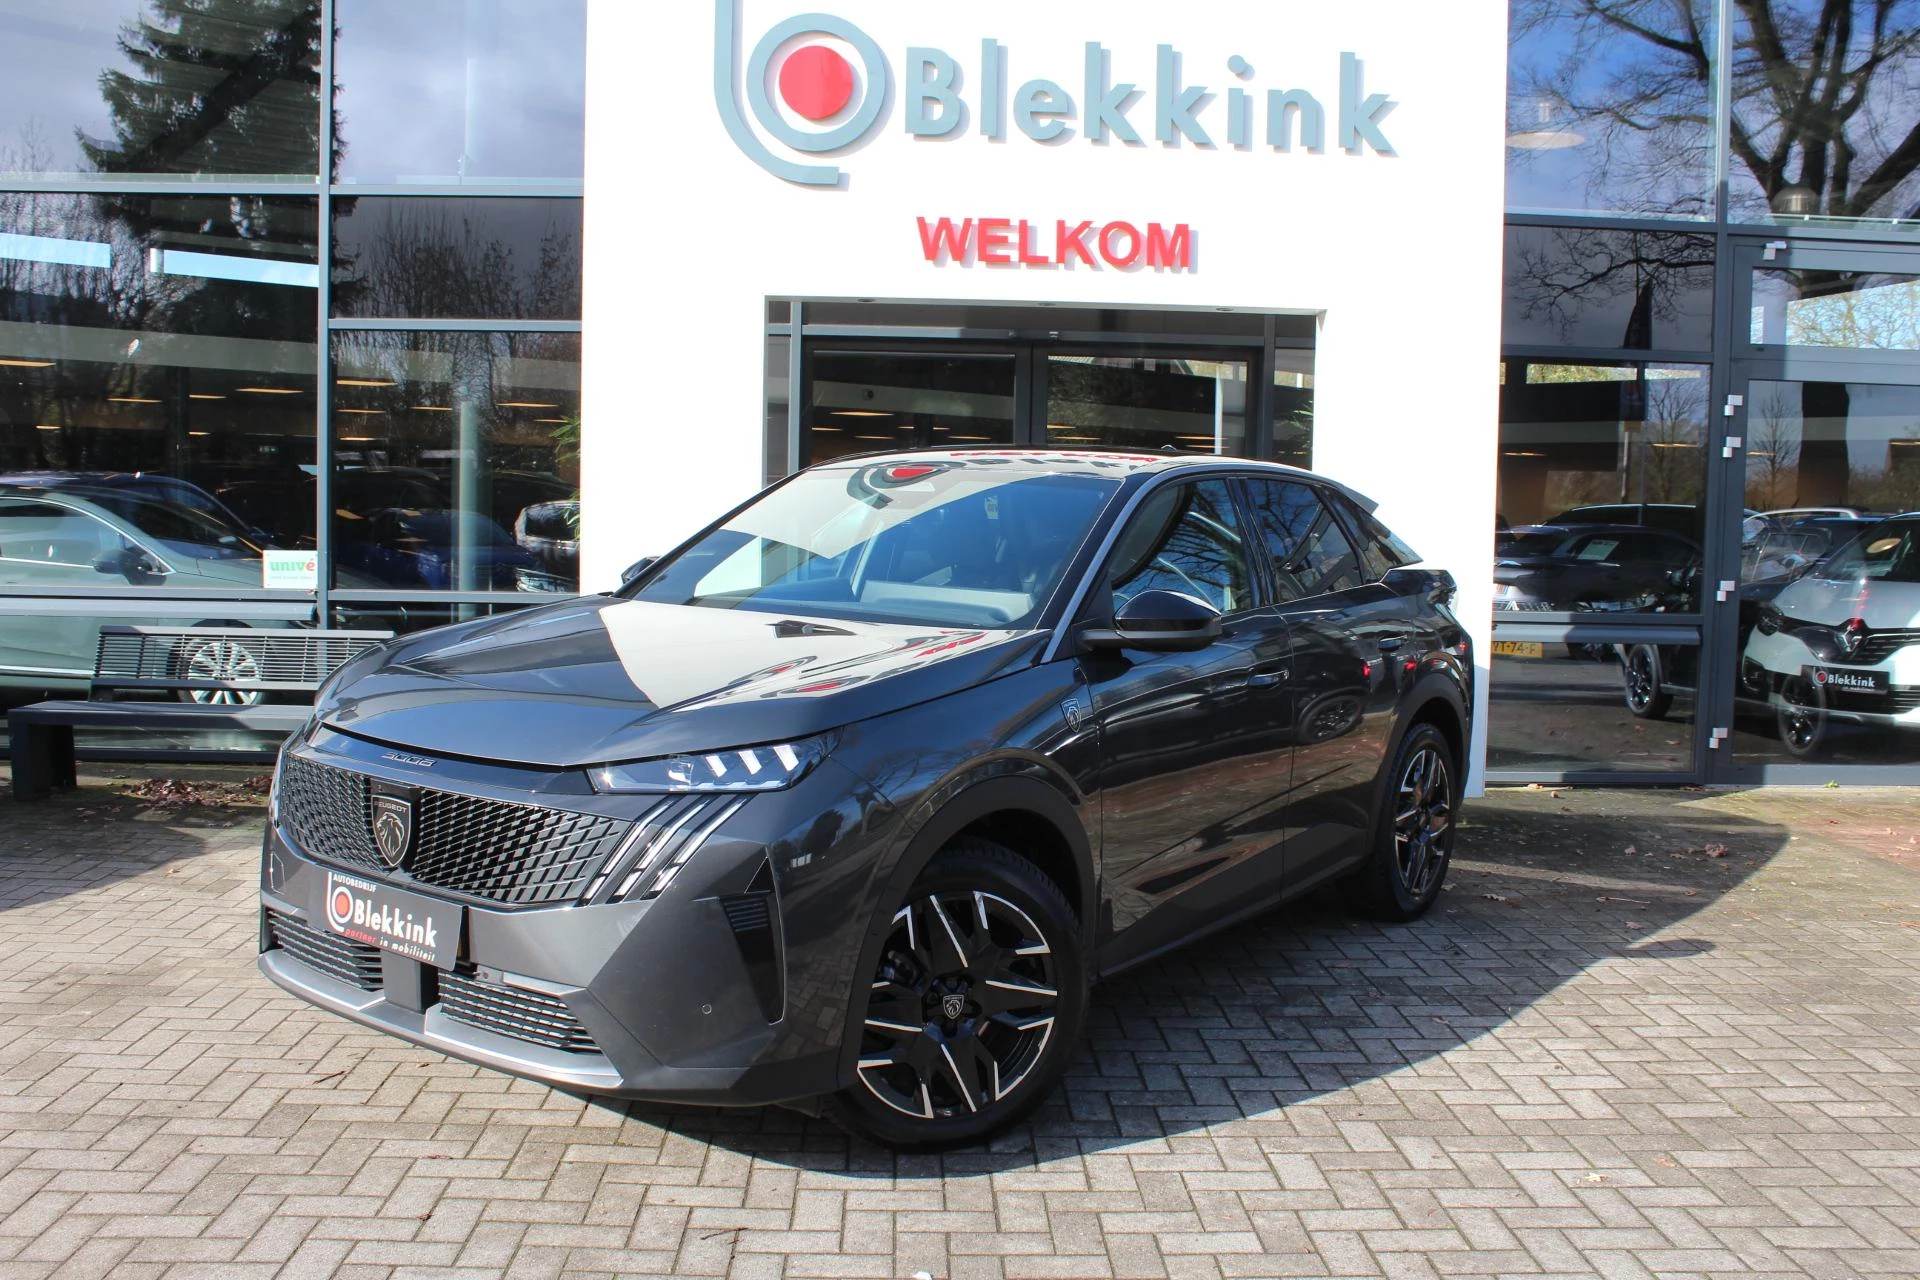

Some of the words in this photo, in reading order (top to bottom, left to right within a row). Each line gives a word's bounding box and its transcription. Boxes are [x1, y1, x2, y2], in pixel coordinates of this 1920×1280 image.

[904, 38, 1393, 153] Blekkink
[916, 216, 1191, 269] WELKOM
[270, 558, 316, 572] univé
[1827, 673, 1876, 688] Blekkink
[381, 751, 436, 767] 3008
[374, 800, 407, 813] PEUGEOT
[332, 873, 377, 893] AUTOBEDRIJF
[353, 898, 438, 948] Blekkink
[344, 928, 377, 944] partner
[379, 936, 389, 947] in
[391, 942, 436, 962] mobiliteit
